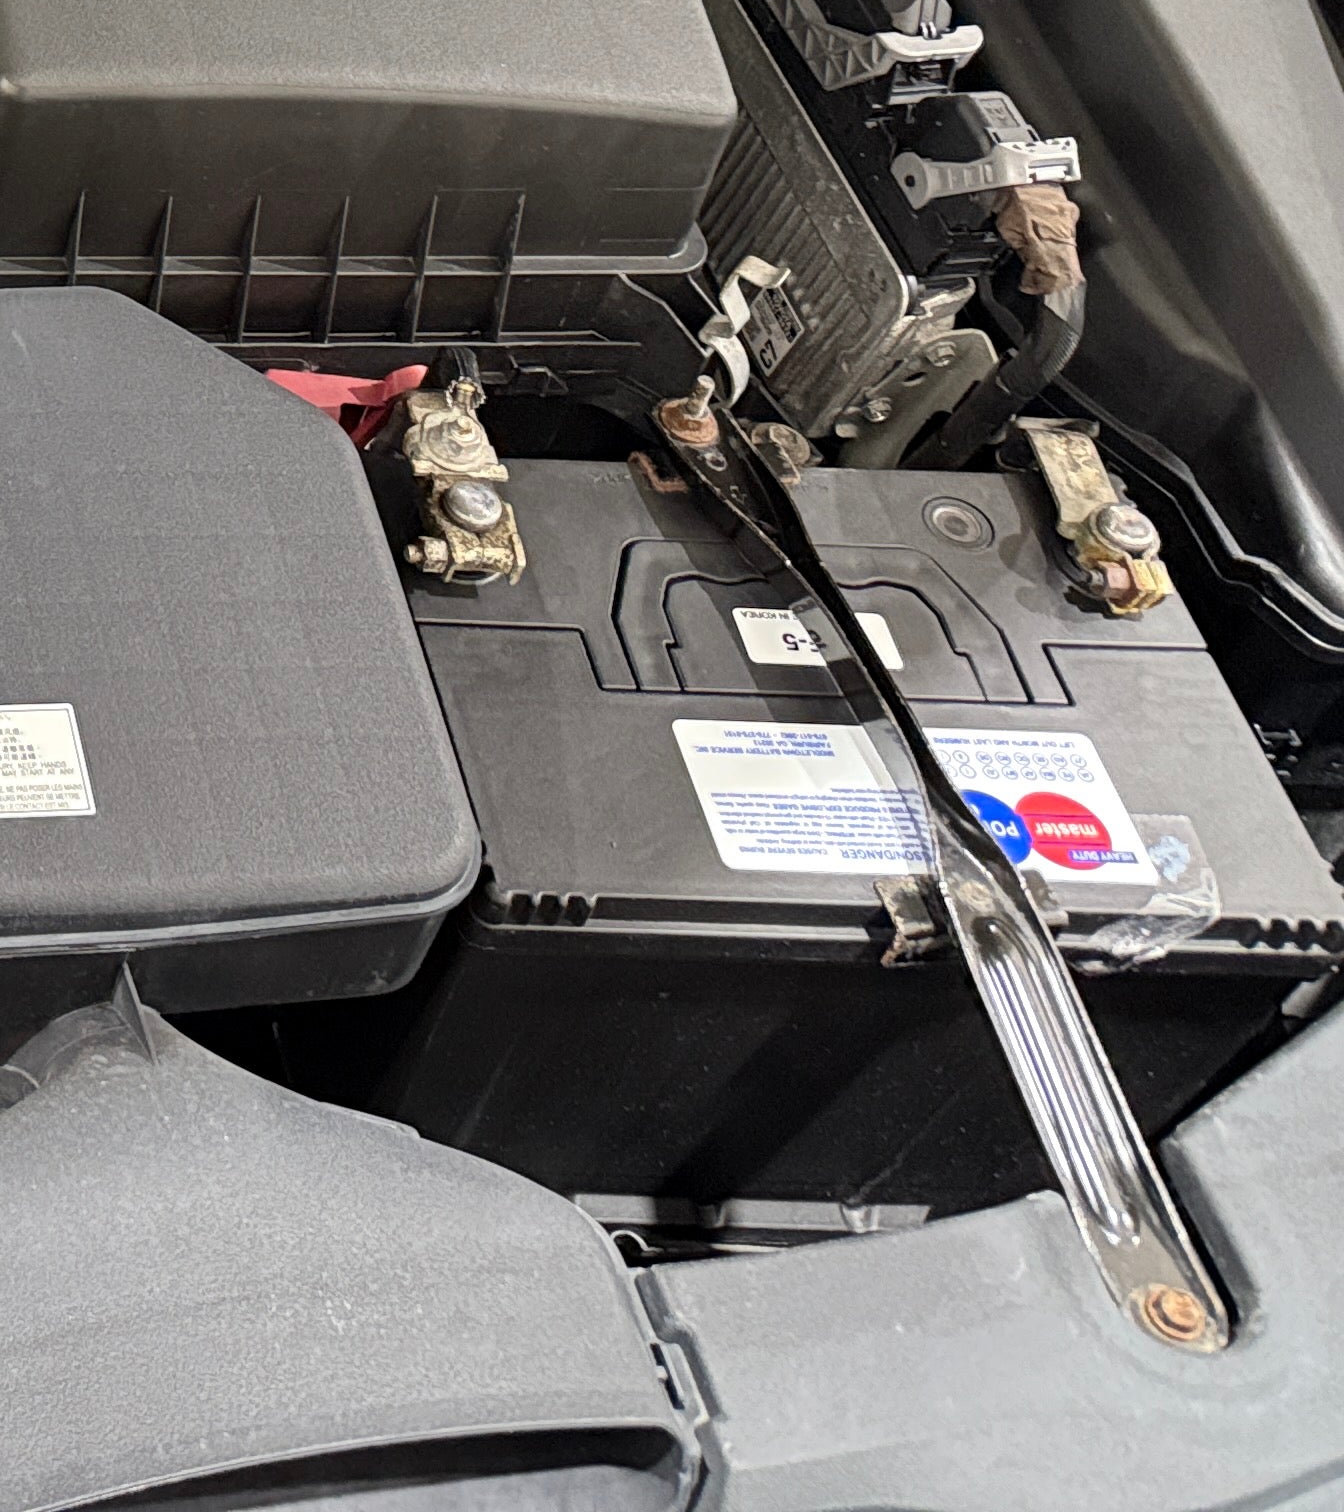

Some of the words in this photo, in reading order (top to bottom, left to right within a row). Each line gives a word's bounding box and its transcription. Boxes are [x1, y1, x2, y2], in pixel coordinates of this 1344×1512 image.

[1033, 821, 1099, 839] master
[1069, 850, 1098, 861] DUTY
[1099, 851, 1135, 862] HEAVY
